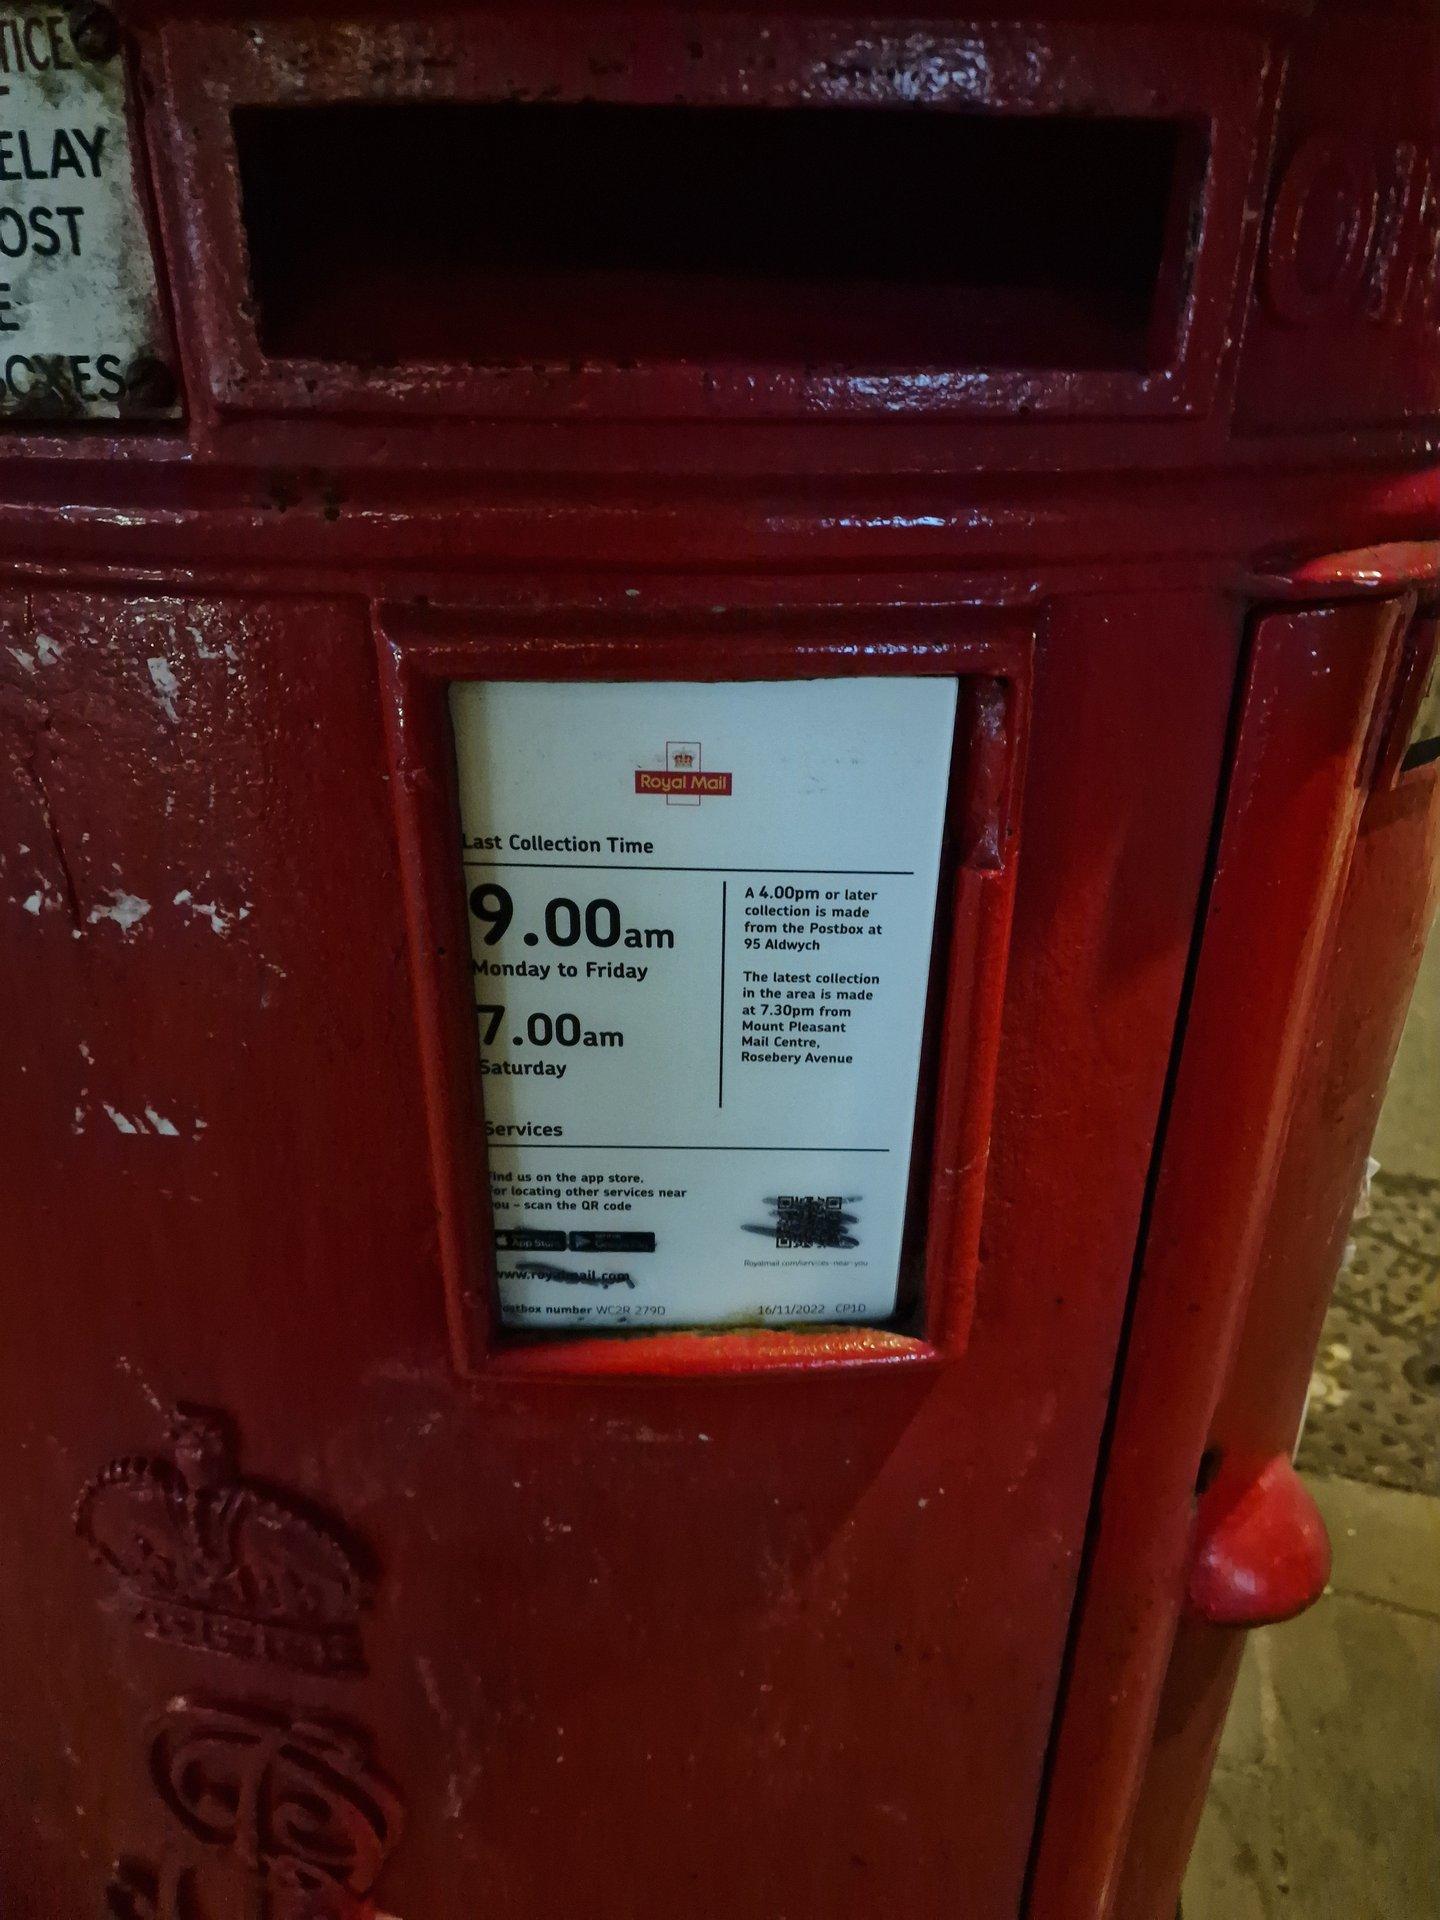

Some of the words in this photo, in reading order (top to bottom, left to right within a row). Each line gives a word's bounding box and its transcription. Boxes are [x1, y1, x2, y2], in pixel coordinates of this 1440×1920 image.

[0, 206, 85, 257] OST
[641, 774, 686, 792] Royal
[691, 776, 727, 790] Mail
[463, 834, 502, 850] Last
[509, 834, 601, 852] Collection
[607, 837, 654, 853] Time
[745, 887, 754, 898] A
[759, 885, 819, 902] 4.00pm
[825, 891, 840, 900] or
[845, 889, 878, 900] later
[469, 883, 675, 949] 9.00am
[745, 905, 810, 916] collection
[816, 905, 826, 917] is
[832, 906, 870, 918] made
[744, 921, 777, 933] from
[783, 922, 804, 934] the
[810, 922, 863, 935] Postbox
[868, 924, 882, 935] at
[744, 938, 761, 949] 95
[765, 938, 820, 952] Aldwych
[472, 959, 550, 980] Monday
[558, 962, 578, 978] to
[586, 961, 648, 982] Friday
[743, 971, 768, 982] The
[773, 972, 811, 983] latest
[816, 973, 880, 984] collection
[743, 987, 755, 998] in
[760, 988, 782, 999] the
[786, 990, 815, 1000] area
[821, 989, 831, 1000] is
[837, 990, 873, 1000] made
[742, 1005, 755, 1015] at
[760, 1004, 814, 1018] 7.30pm
[819, 1005, 851, 1017] from
[475, 1004, 624, 1048] 7.00am
[742, 1020, 784, 1031] Mount
[789, 1021, 846, 1033] Pleasant
[742, 1036, 769, 1047] Mail
[774, 1036, 820, 1049] Centre,
[741, 1051, 801, 1065] Rosebery
[805, 1052, 853, 1064] Avenue
[480, 1059, 567, 1079] Saturday
[485, 1121, 563, 1137] Services
[517, 1173, 531, 1182] us
[536, 1173, 551, 1182] on
[556, 1172, 576, 1183] the
[581, 1174, 604, 1185] app
[608, 1173, 643, 1183] store.
[511, 1185, 561, 1198] locating
[566, 1186, 599, 1197] other
[604, 1187, 654, 1197] services
[658, 1188, 687, 1197] near
[524, 1201, 552, 1210] scan
[557, 1200, 576, 1210] the
[581, 1200, 599, 1212] QR
[604, 1201, 632, 1211] code
[503, 1304, 542, 1315] ostbox
[546, 1305, 592, 1315] number
[596, 1305, 631, 1315] WC2R
[758, 1304, 825, 1315] 16/11/2022
